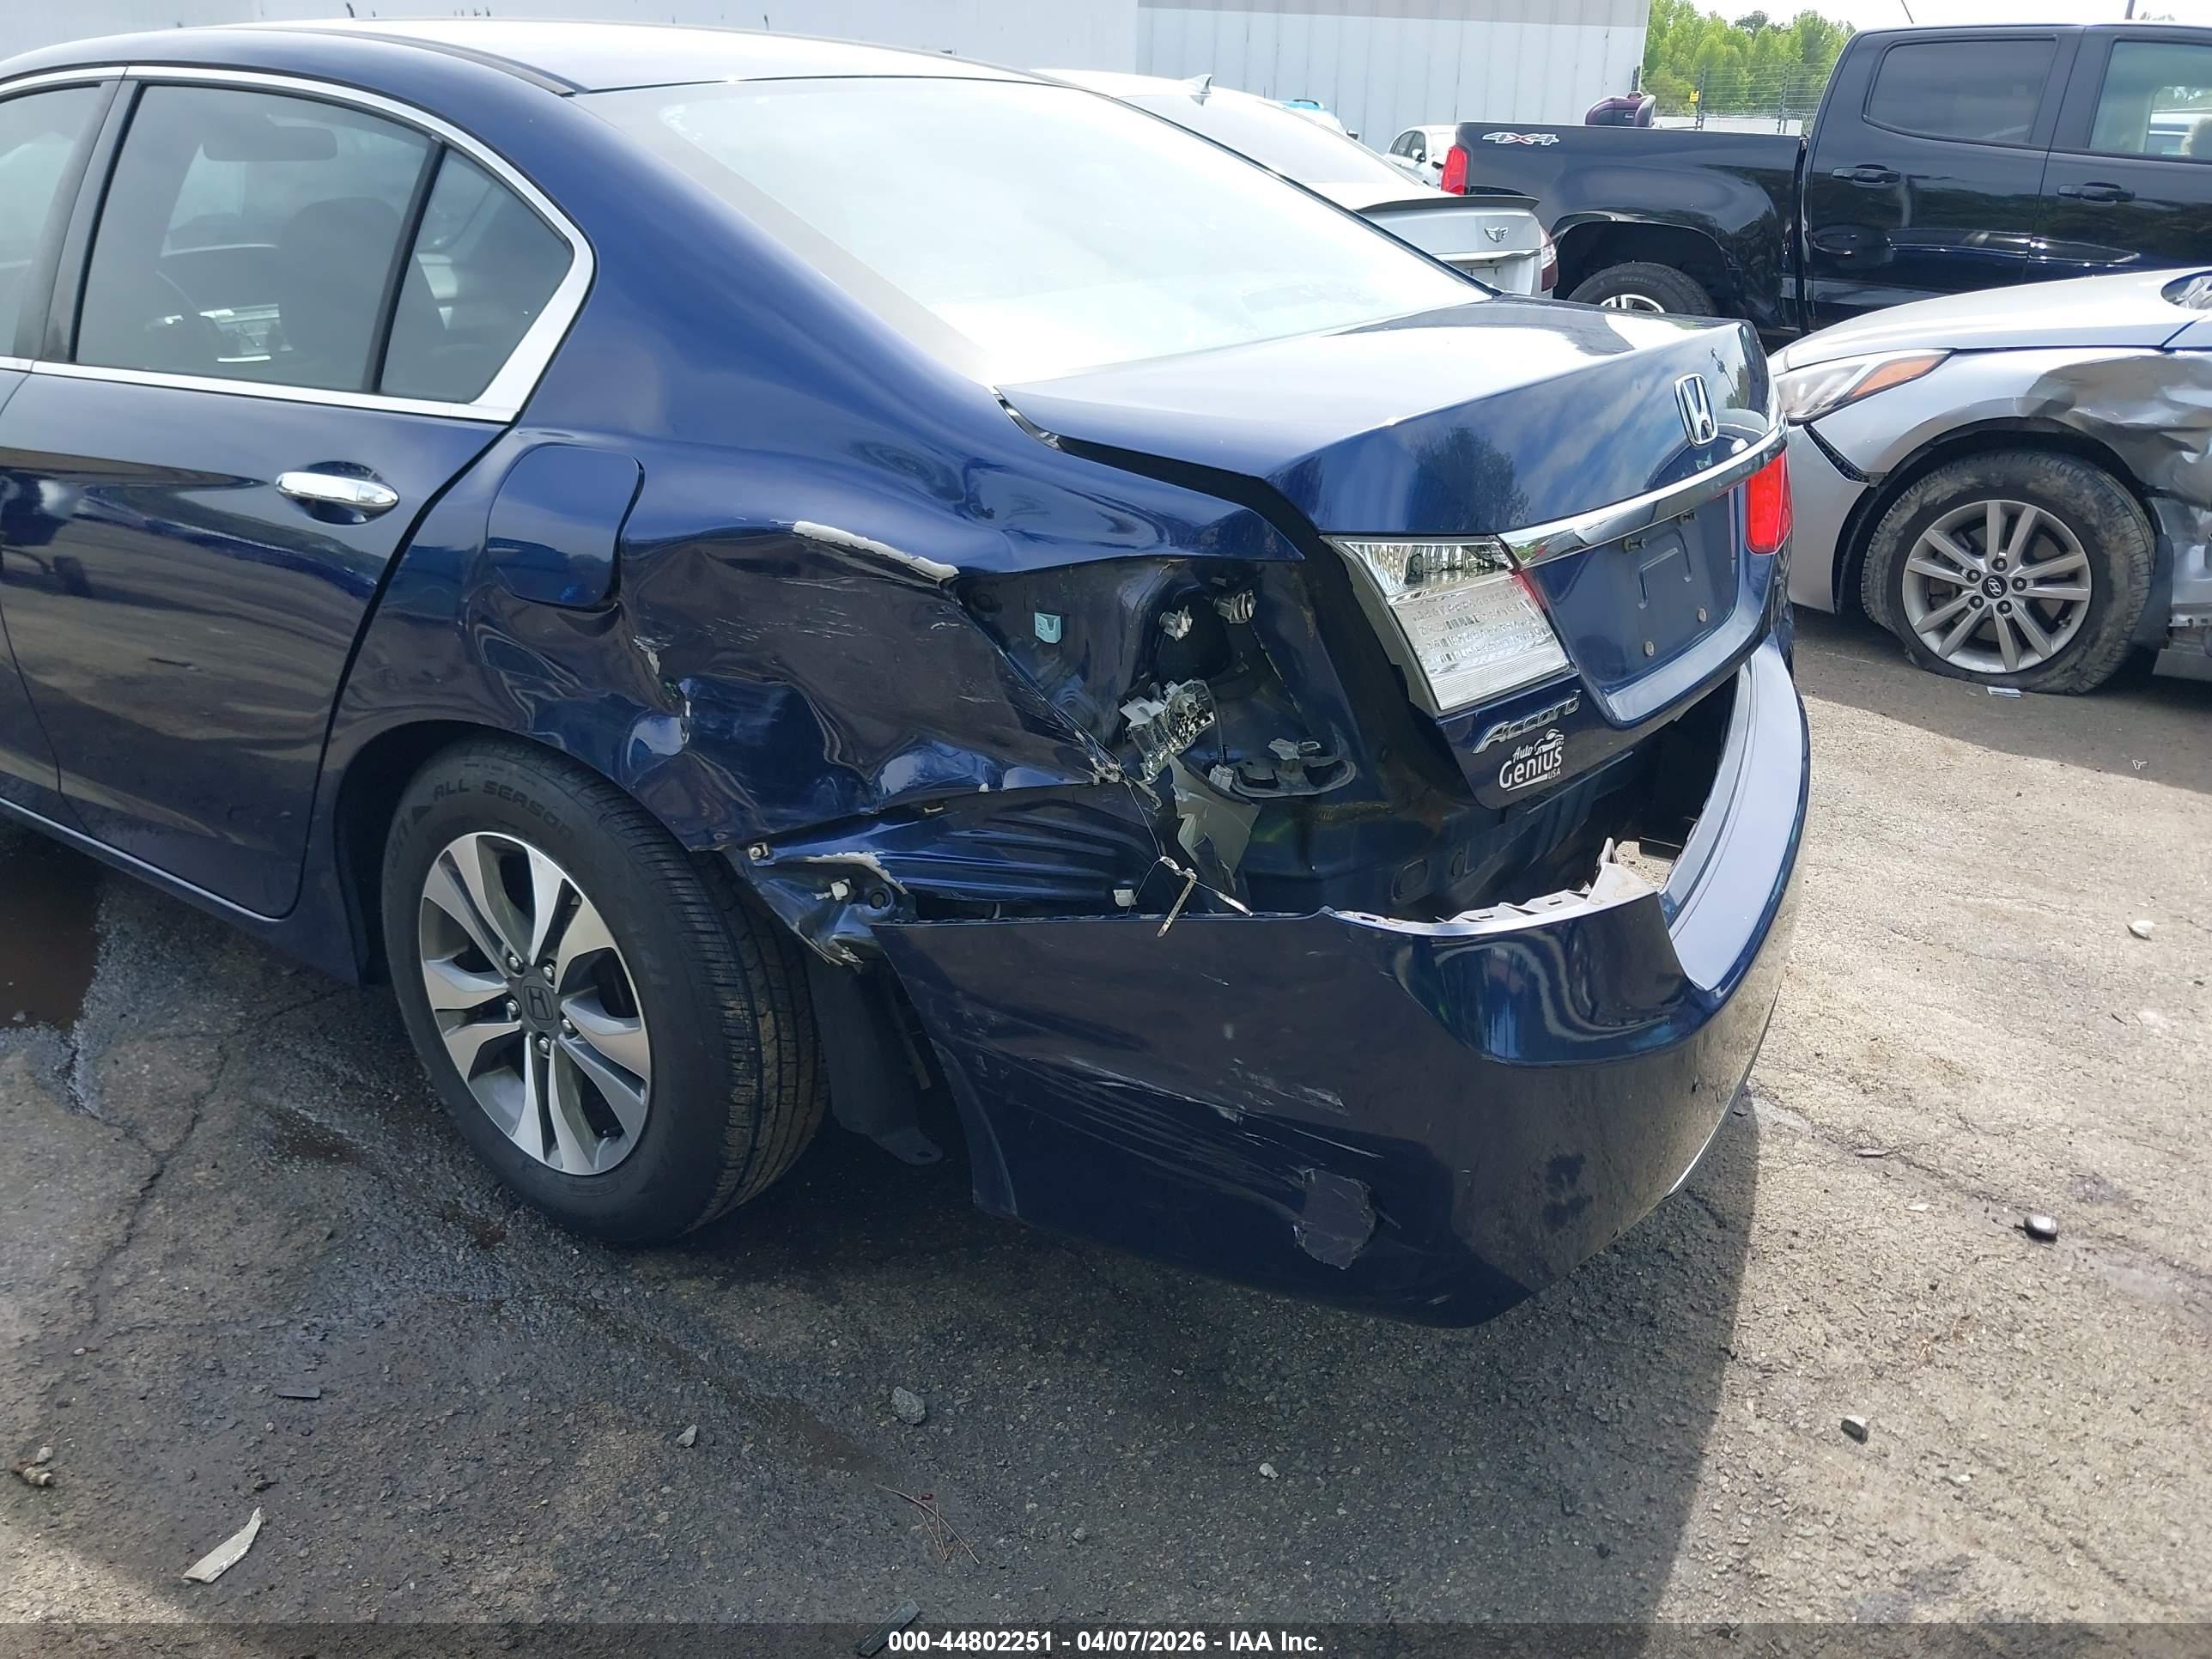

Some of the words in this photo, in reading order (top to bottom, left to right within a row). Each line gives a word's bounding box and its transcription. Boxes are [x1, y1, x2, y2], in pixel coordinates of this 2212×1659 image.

[1473, 689, 1582, 754] Accord
[1512, 745, 1534, 763] Auto
[1547, 767, 1561, 780] USA
[434, 778, 471, 801] ALL
